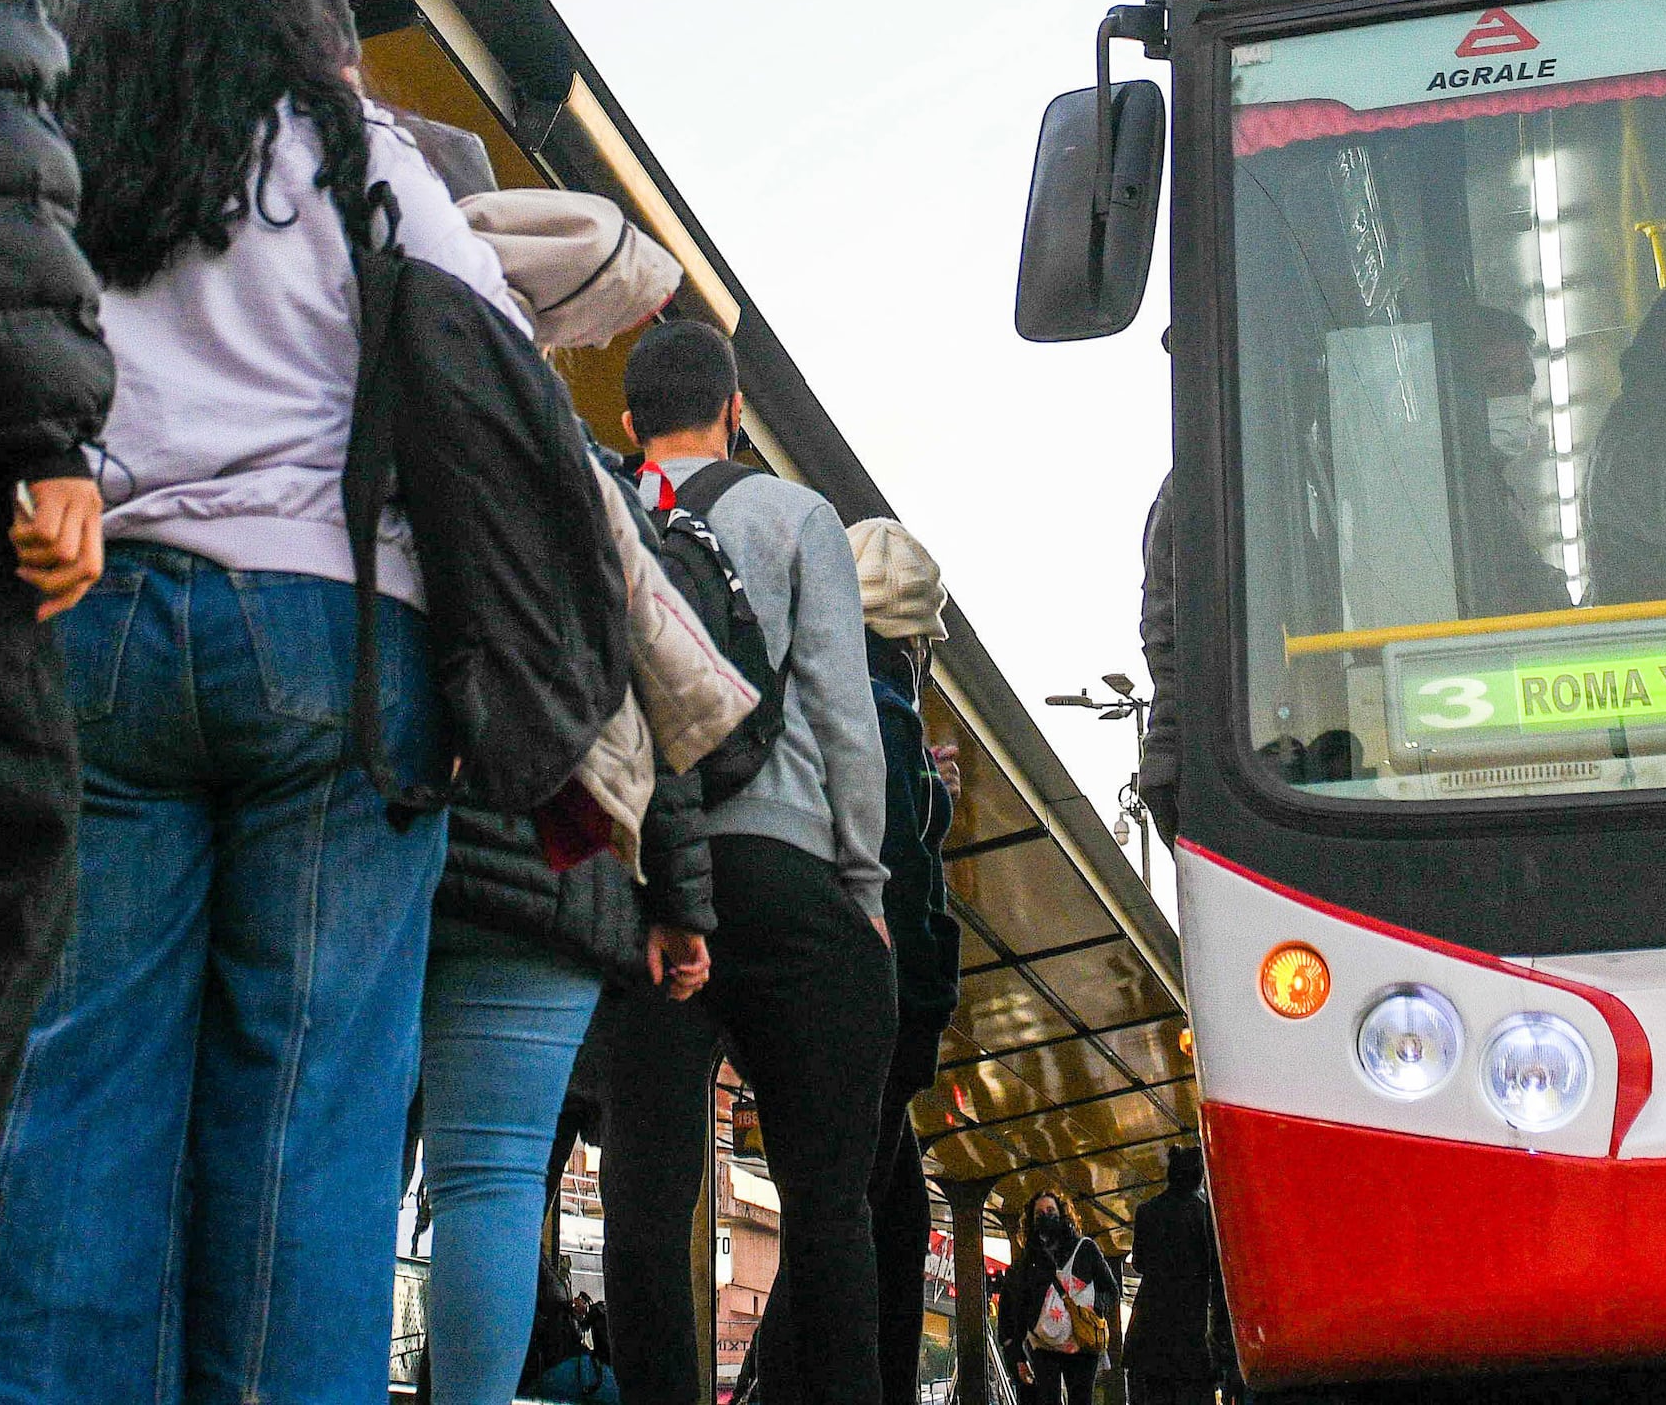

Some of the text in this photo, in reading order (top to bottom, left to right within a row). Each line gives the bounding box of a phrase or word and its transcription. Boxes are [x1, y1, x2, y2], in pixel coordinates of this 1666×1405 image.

[1426, 58, 1557, 92] AGRALE
[1418, 677, 1495, 729] 3
[1522, 669, 1652, 716] ROMA
